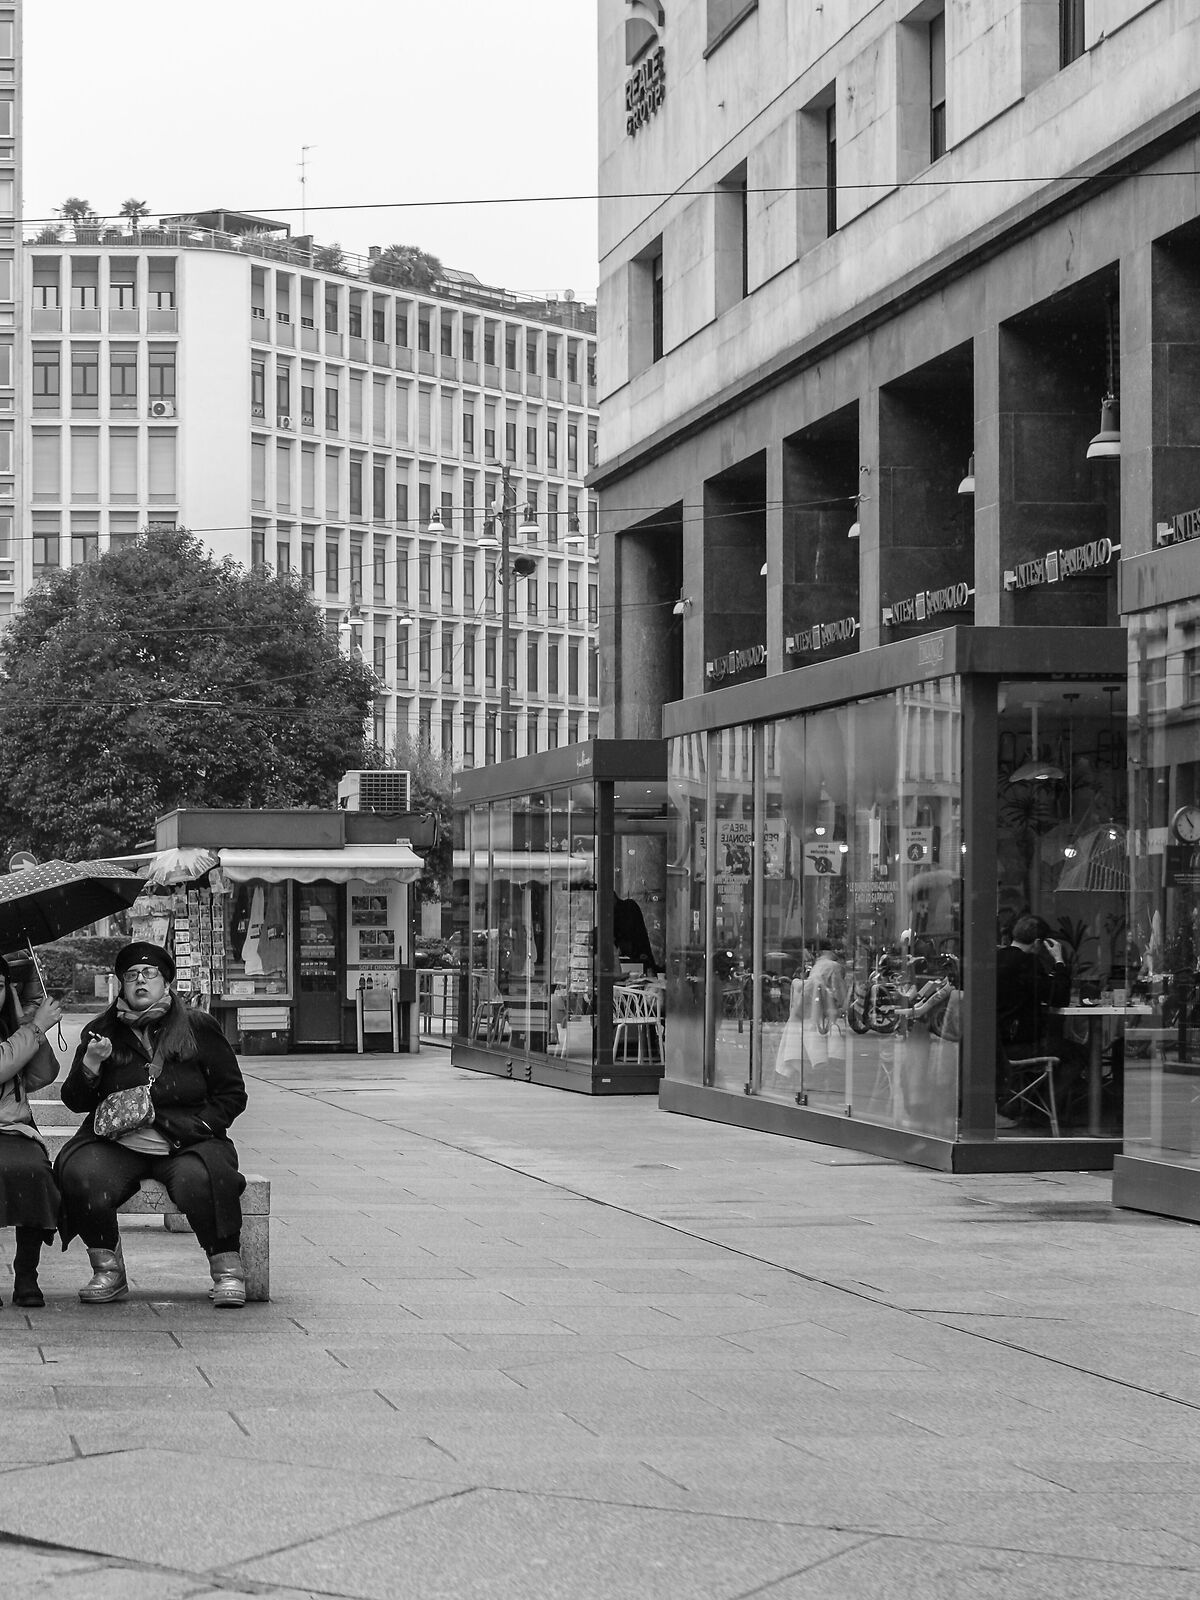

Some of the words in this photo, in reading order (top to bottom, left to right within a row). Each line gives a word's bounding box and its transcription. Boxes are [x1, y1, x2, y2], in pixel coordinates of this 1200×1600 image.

[626, 46, 665, 111] REALE
[626, 82, 665, 137] GROUP
[1016, 558, 1048, 589] INTESA
[1059, 538, 1112, 581] SANPAOLO
